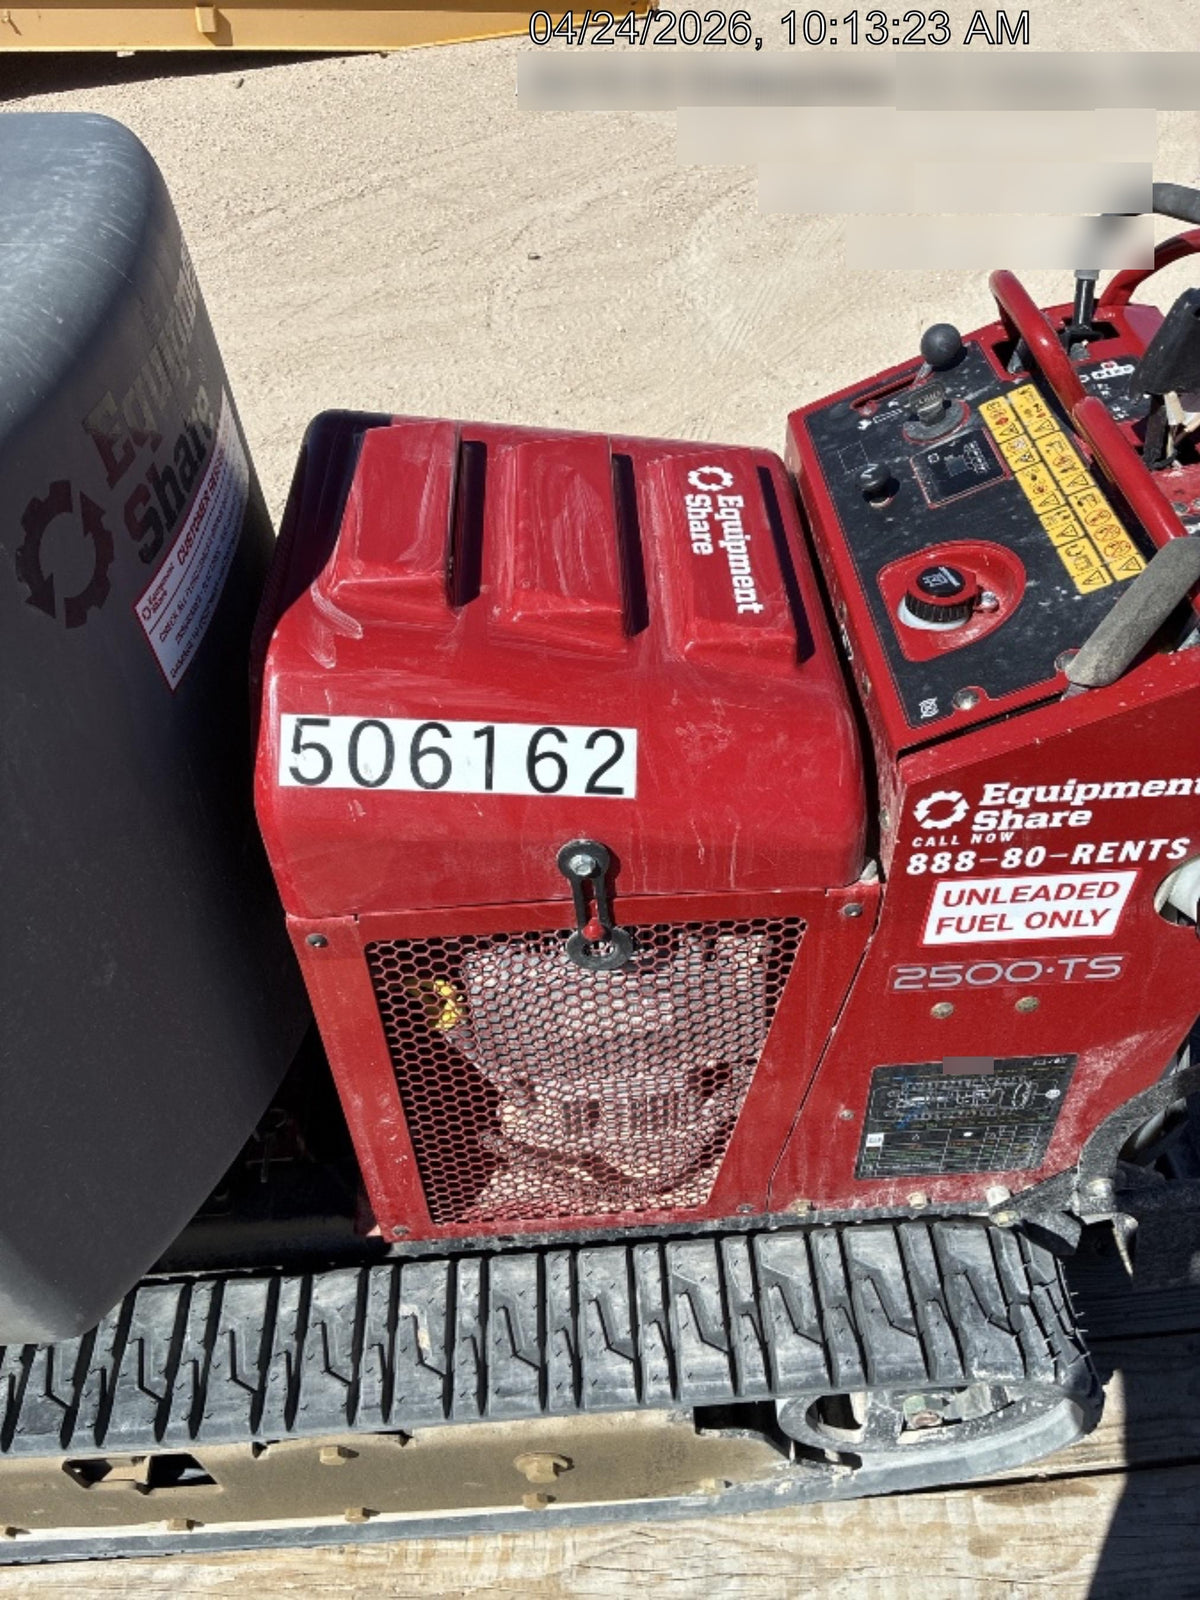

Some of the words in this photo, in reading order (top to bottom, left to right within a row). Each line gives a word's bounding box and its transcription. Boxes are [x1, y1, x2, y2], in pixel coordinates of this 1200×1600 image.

[684, 493, 714, 556] Share
[714, 493, 764, 615] Equipment
[289, 717, 625, 795] 506162
[971, 809, 1093, 832] Share
[906, 837, 1191, 875] 888-80-RENTS
[911, 834, 961, 848] CALL
[971, 831, 1015, 844] NOW
[942, 881, 1121, 908] UNLEADED
[934, 912, 1014, 936] FUEL
[1025, 907, 1112, 930] ONLY
